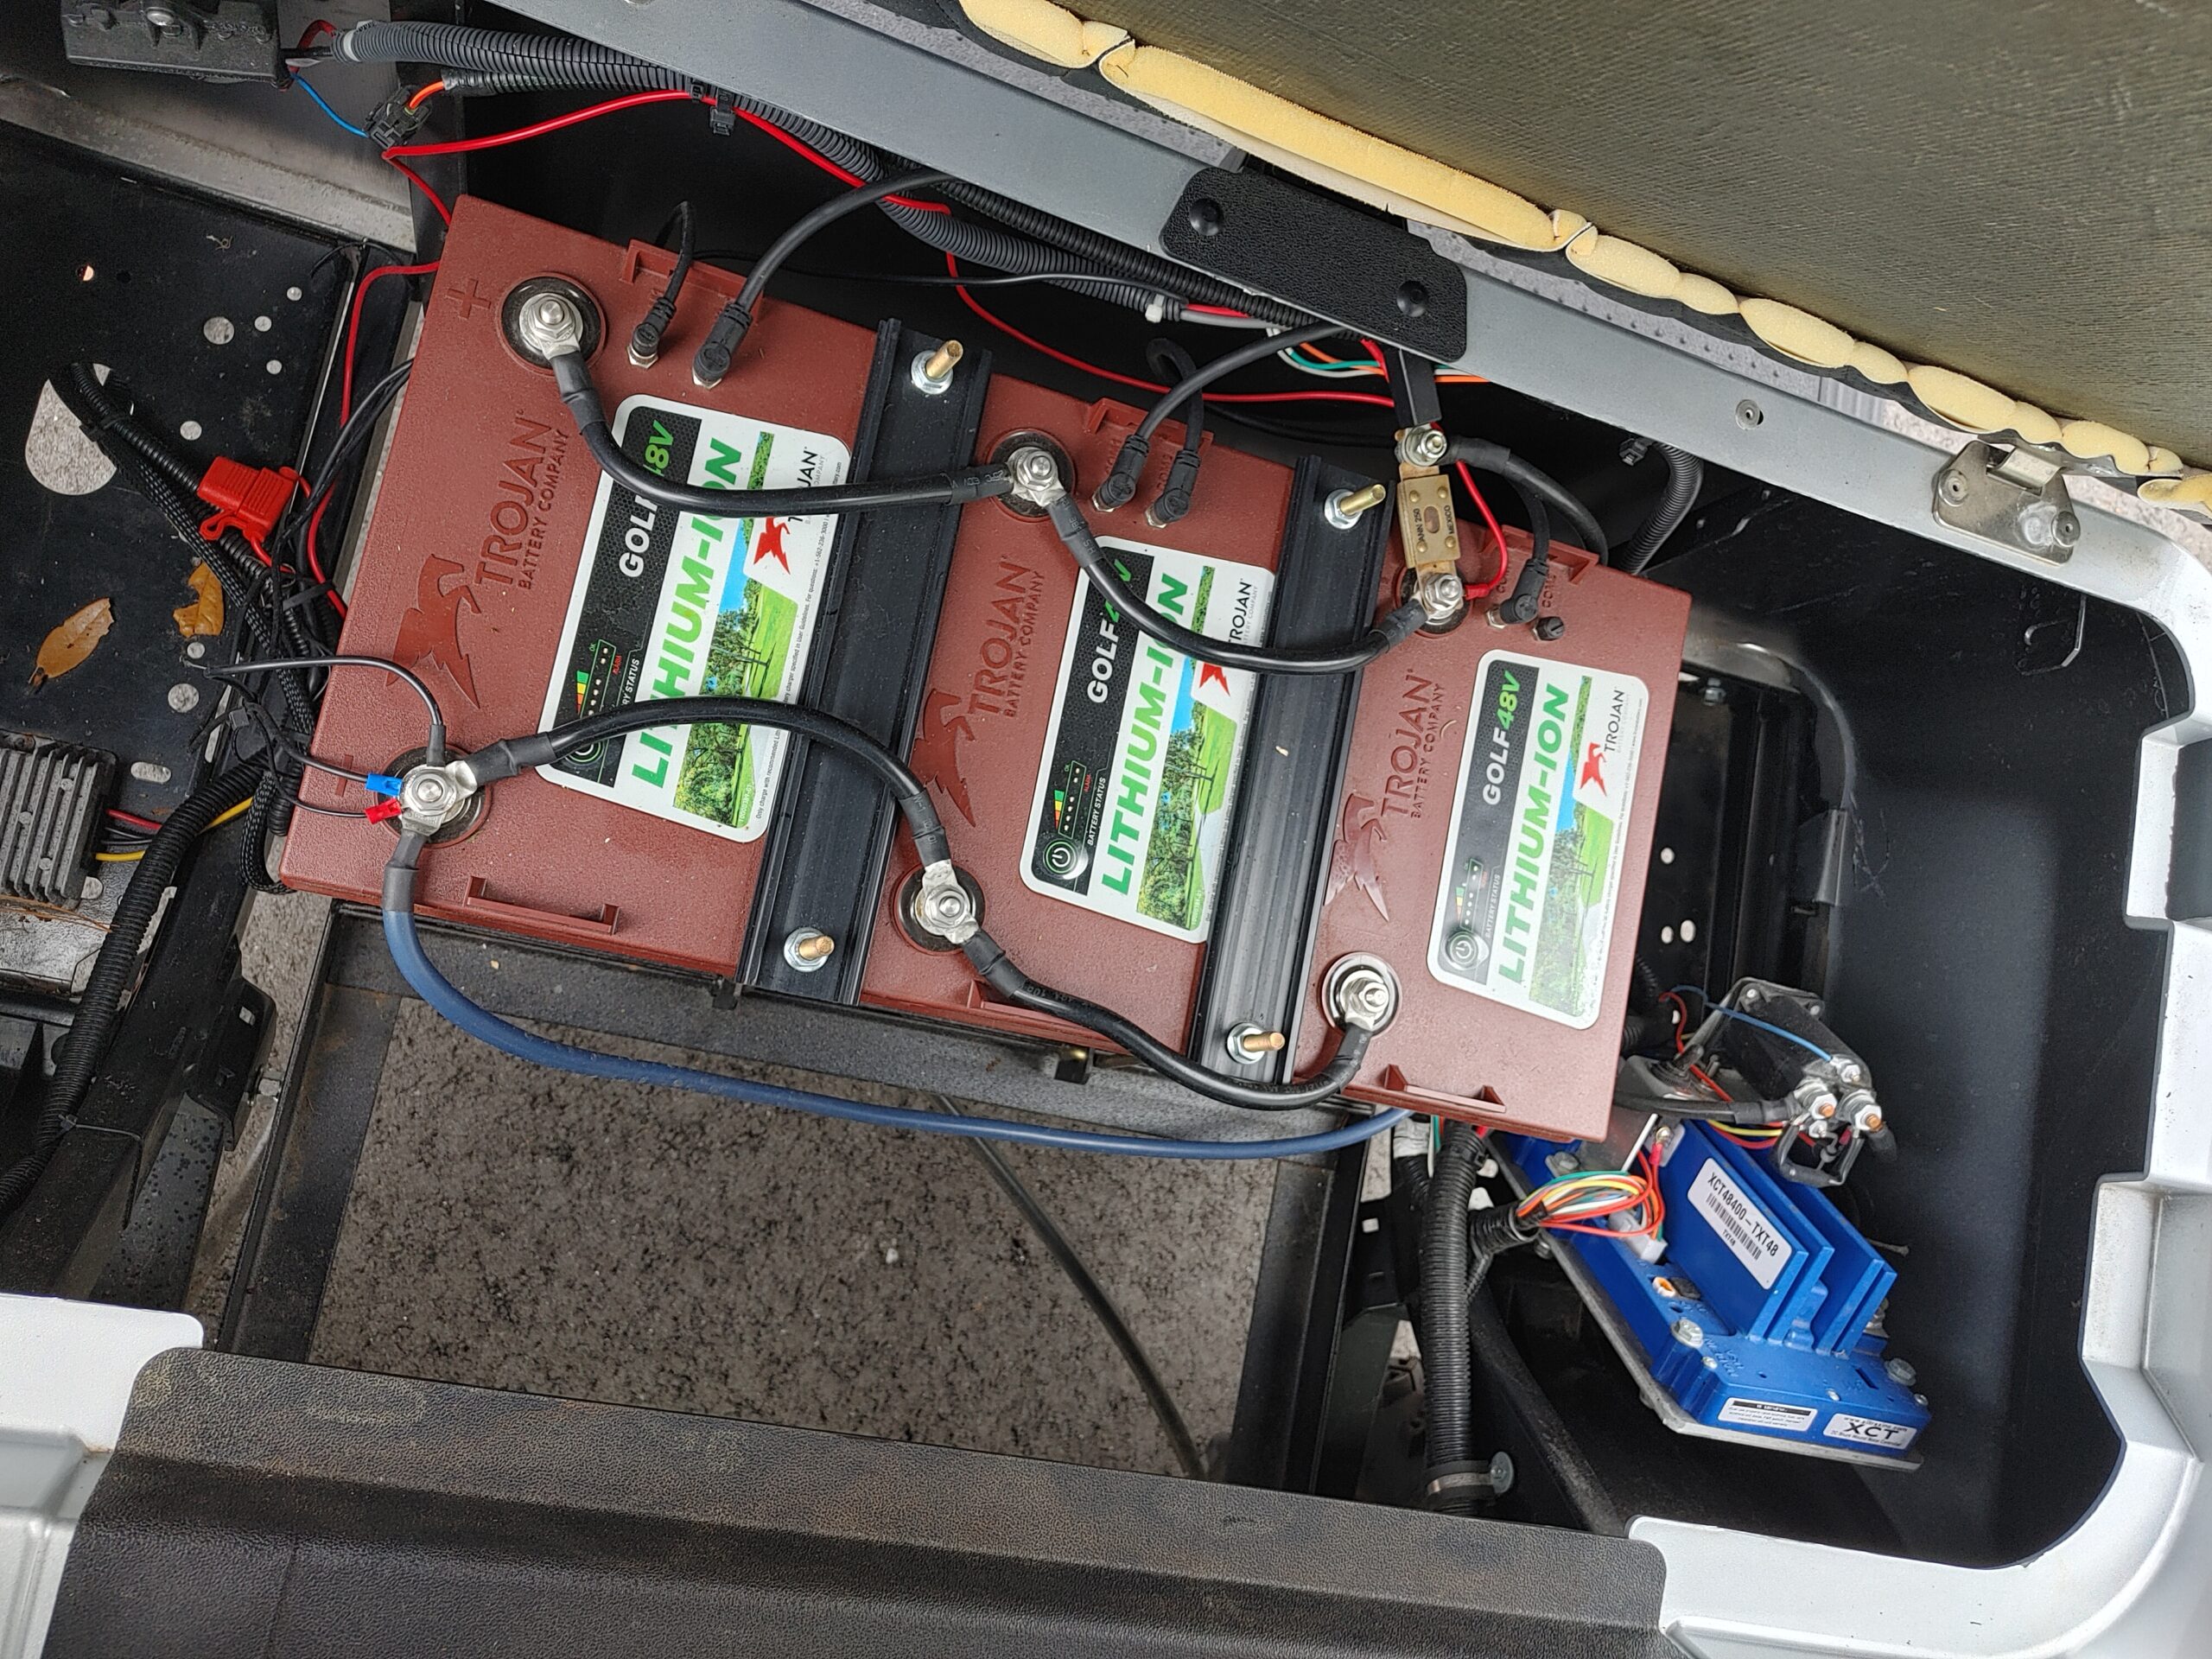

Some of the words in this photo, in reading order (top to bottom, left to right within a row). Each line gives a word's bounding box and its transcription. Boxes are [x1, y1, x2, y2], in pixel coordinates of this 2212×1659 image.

[787, 449, 818, 521] TJAN
[814, 455, 824, 485] OMPANY
[471, 416, 554, 592] TROJAN
[516, 515, 548, 590] BATTERY
[536, 429, 569, 512] COMPANY
[1413, 508, 1421, 522] 250
[1415, 524, 1424, 542] ANN
[1443, 505, 1454, 534] MEXICO
[631, 437, 742, 788] LIHIUM-IN
[967, 560, 1031, 715] TROJAN
[1002, 650, 1027, 718] BATTERY
[1017, 570, 1045, 647] COMPANY
[1084, 558, 1134, 704] GOLFV
[1227, 581, 1253, 644] ROJAN
[625, 658, 639, 692] STATUS
[785, 671, 795, 691] charger
[789, 648, 800, 671] specified
[1380, 674, 1433, 816] TROJAN
[1410, 757, 1431, 819] BATTERY
[1422, 683, 1446, 753] COMPANY
[1603, 689, 1624, 753] TROJAN
[765, 740, 779, 776] recommended
[754, 807, 764, 819] Only
[758, 788, 768, 806] charge
[1087, 809, 1099, 845] BATTERY
[1094, 777, 1105, 808] STATUS
[1497, 683, 1569, 984] LITHIUM-ION
[1484, 904, 1495, 938] BATTERY
[1490, 874, 1500, 903] STATUS
[1722, 1229, 1736, 1246] TXT48
[1843, 1422, 1898, 1439] XCT
